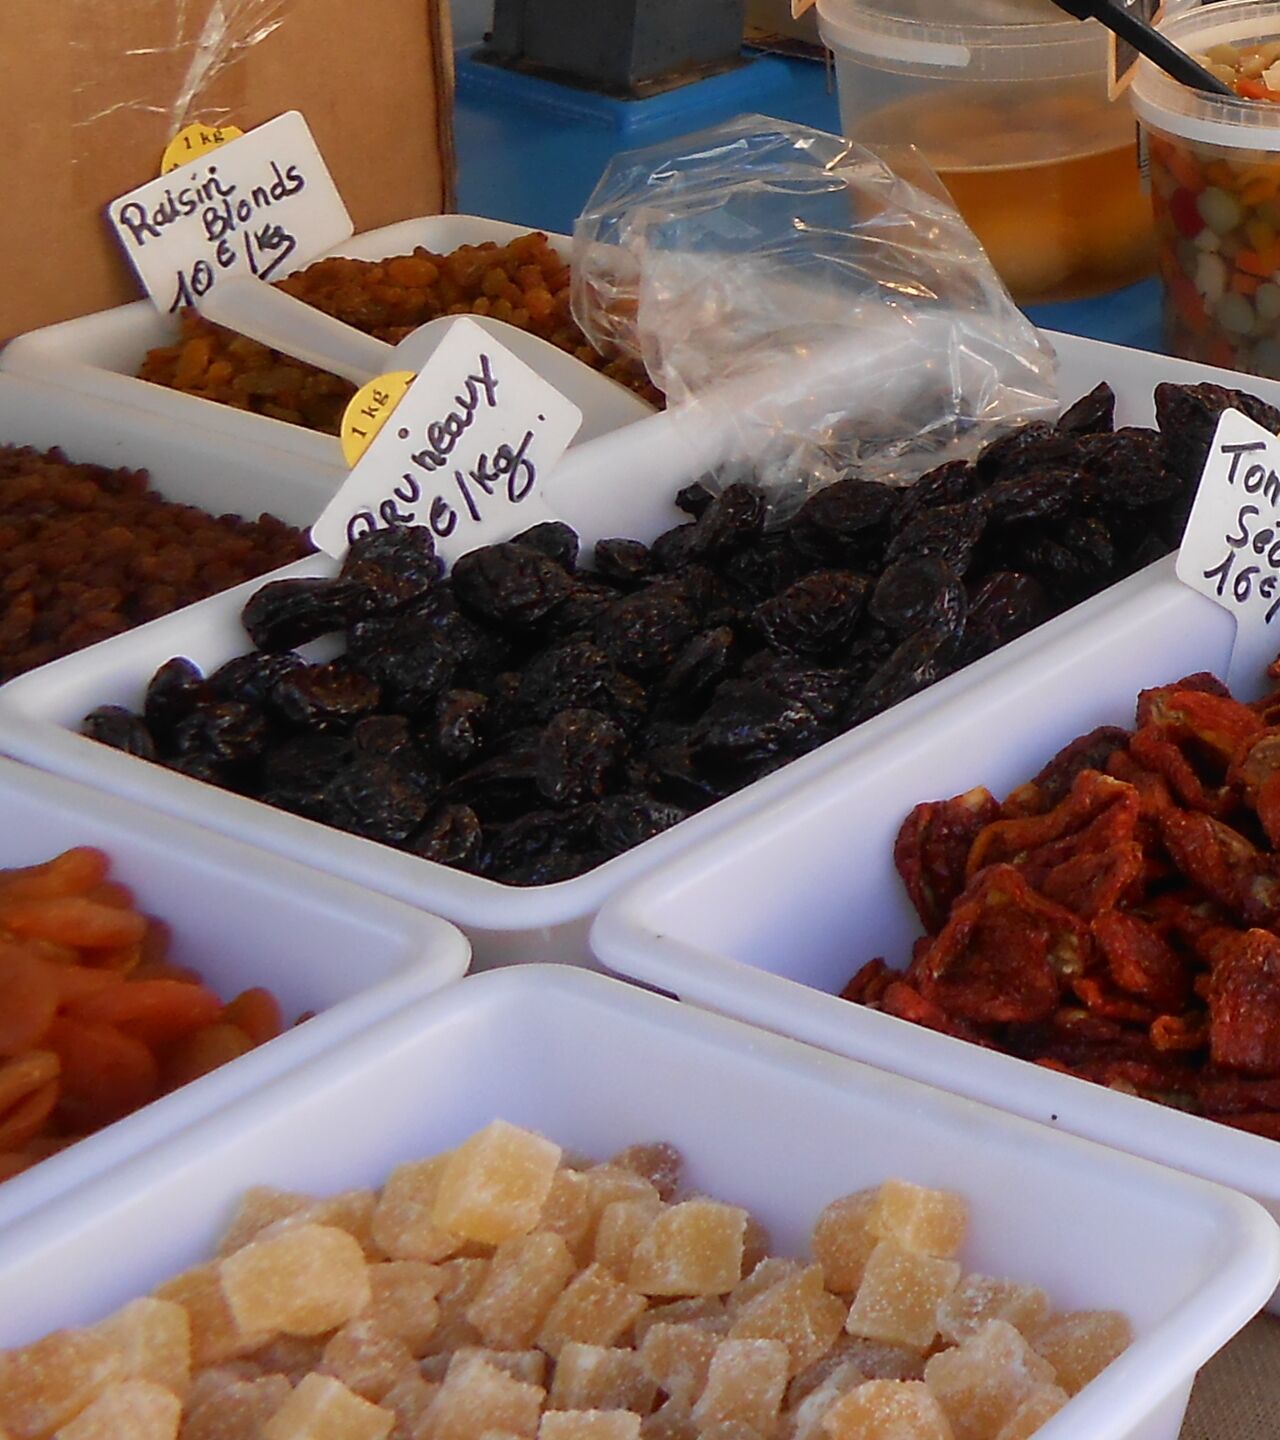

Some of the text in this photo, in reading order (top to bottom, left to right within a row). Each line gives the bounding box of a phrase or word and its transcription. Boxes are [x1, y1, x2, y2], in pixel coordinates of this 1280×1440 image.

[183, 127, 224, 151] 1 kg
[119, 165, 236, 246] Raisin
[201, 160, 306, 243] Blonds
[351, 387, 390, 441] 1 kg
